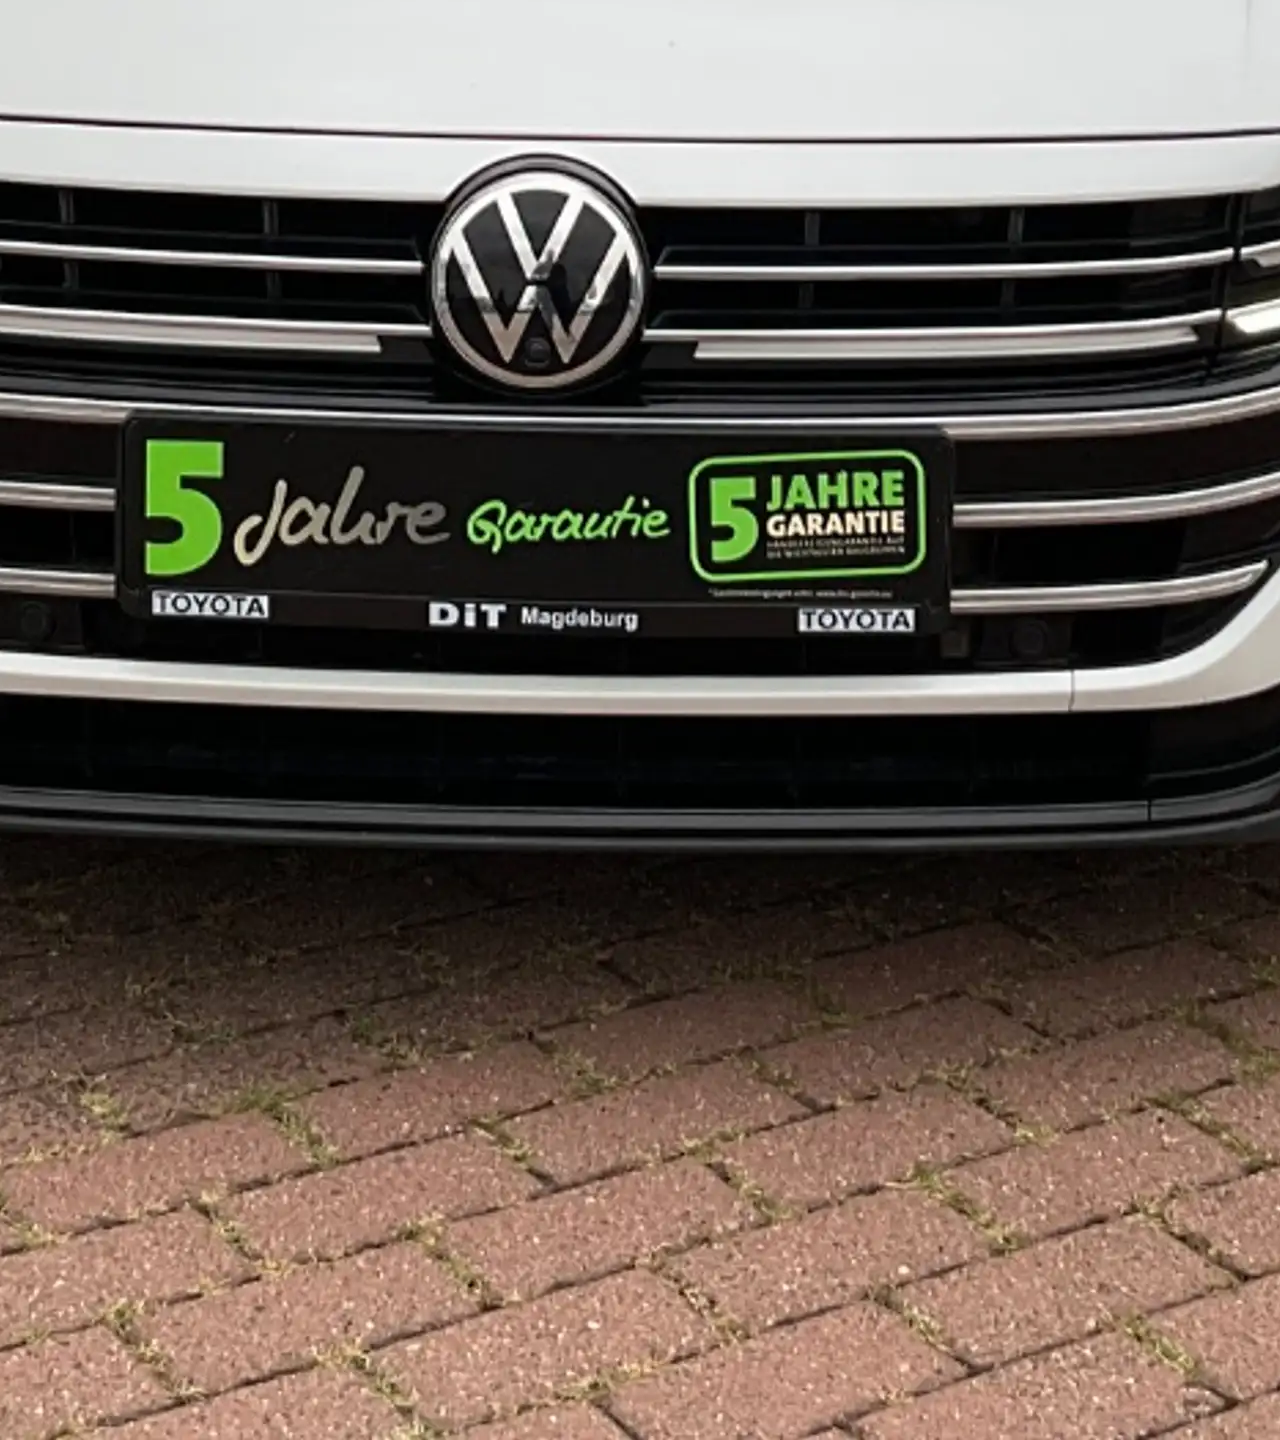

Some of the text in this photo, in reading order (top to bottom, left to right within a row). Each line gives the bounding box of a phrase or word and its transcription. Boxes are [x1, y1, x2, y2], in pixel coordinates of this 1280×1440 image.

[433, 173, 643, 388] VW
[145, 439, 223, 575] 5
[234, 465, 451, 566] Jahre
[710, 470, 905, 563] 5 JAHRE
[766, 510, 905, 537] GARANTIE
[156, 594, 266, 616] TOYOTA
[521, 606, 639, 633] Magdeburg
[802, 610, 911, 631] TOYOTA
